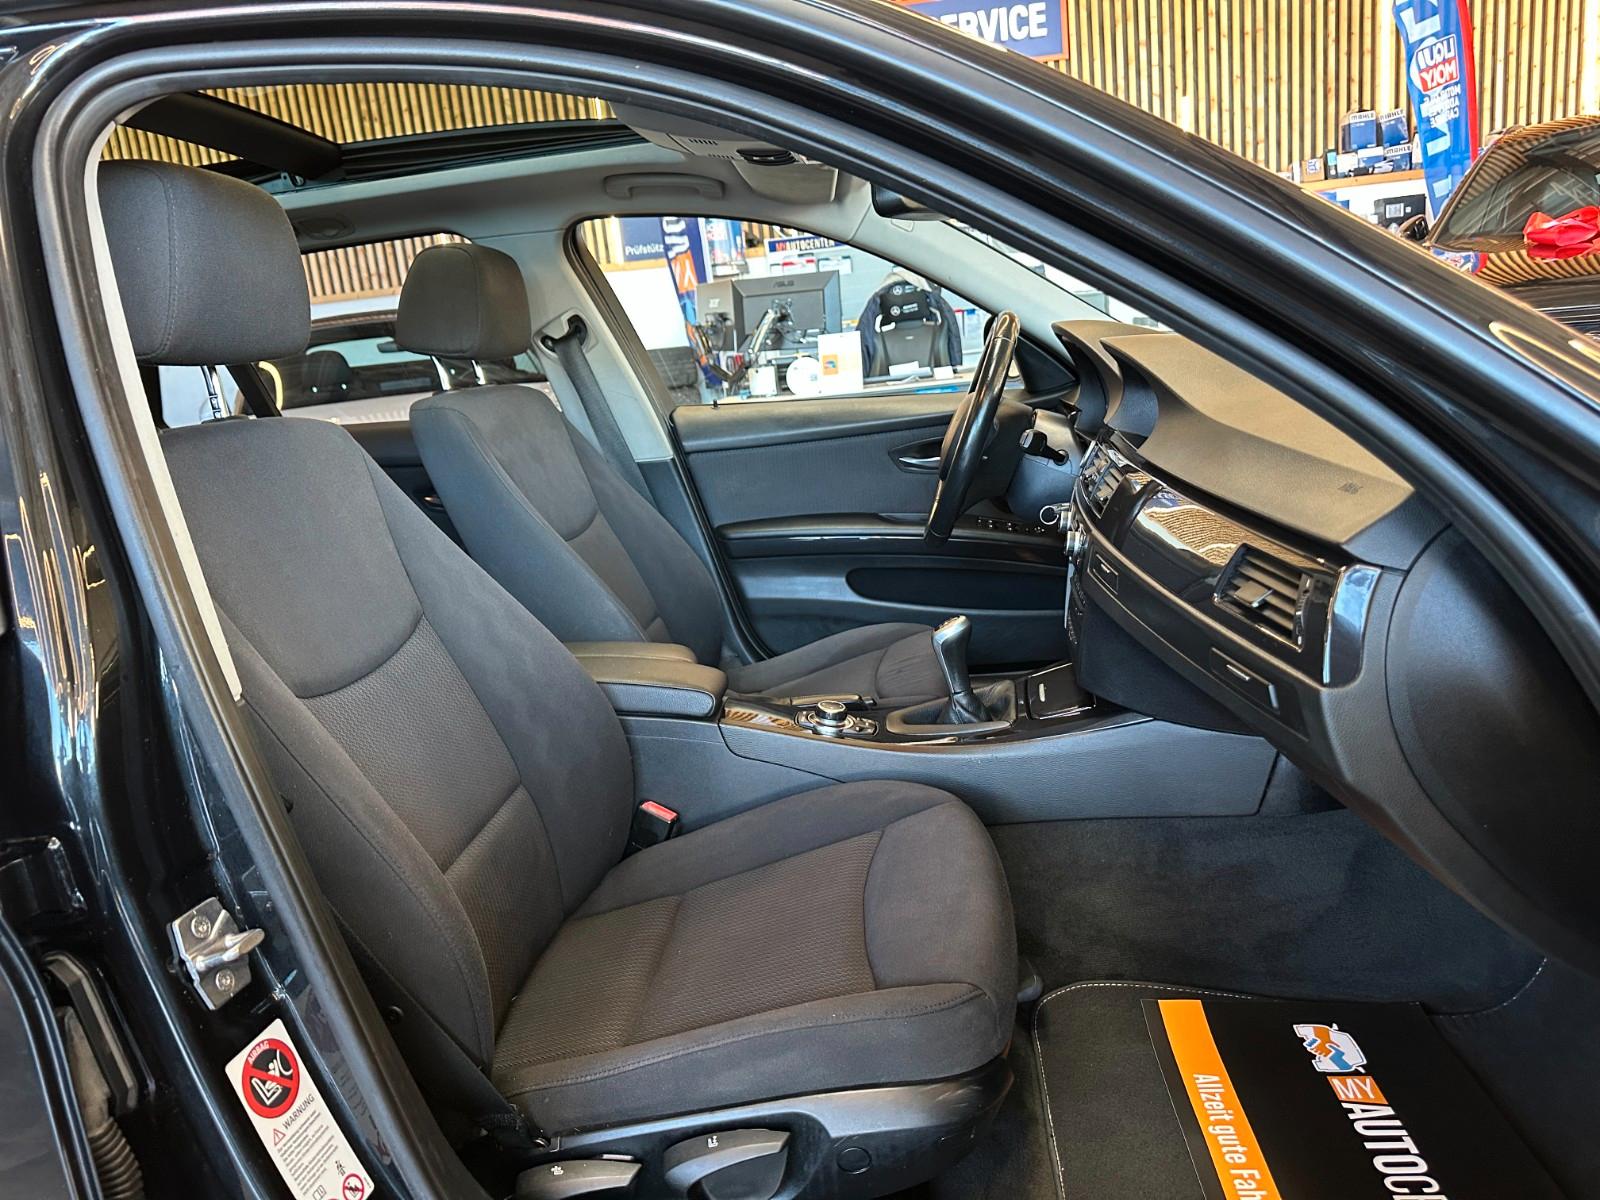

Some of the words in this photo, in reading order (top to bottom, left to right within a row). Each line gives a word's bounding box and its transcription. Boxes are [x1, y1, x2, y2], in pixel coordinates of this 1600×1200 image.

[930, 2, 1048, 42] RVICE
[248, 1041, 270, 1064] AIRBAG
[1193, 1073, 1234, 1122] Allzeit
[1331, 1078, 1375, 1099] MY
[282, 1093, 316, 1130] WARNUNG
[1207, 1125, 1248, 1164] gute
